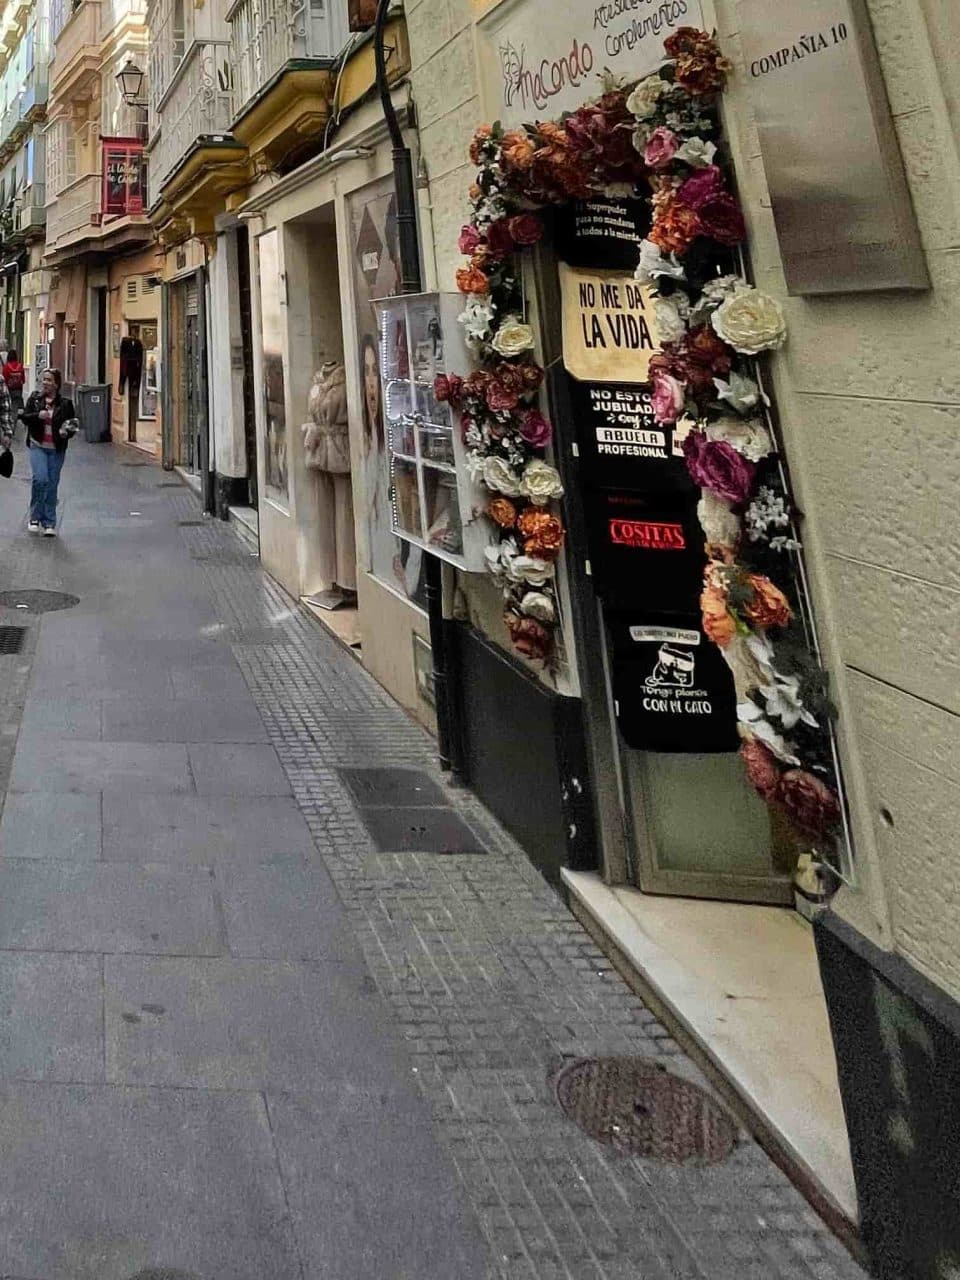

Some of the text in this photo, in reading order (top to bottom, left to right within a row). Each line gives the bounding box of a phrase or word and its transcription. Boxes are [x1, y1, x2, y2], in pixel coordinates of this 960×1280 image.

[830, 22, 848, 44] 10
[579, 282, 645, 310] NO ME DA
[581, 313, 655, 350] LA VIDA
[590, 389, 652, 402] NO ESTO
[592, 401, 657, 415] JUBILAD
[603, 430, 659, 444] ABUELA
[597, 443, 669, 459] PROFESIONAL
[610, 521, 686, 548] COSITAS
[642, 698, 712, 714] CON MI GATO
